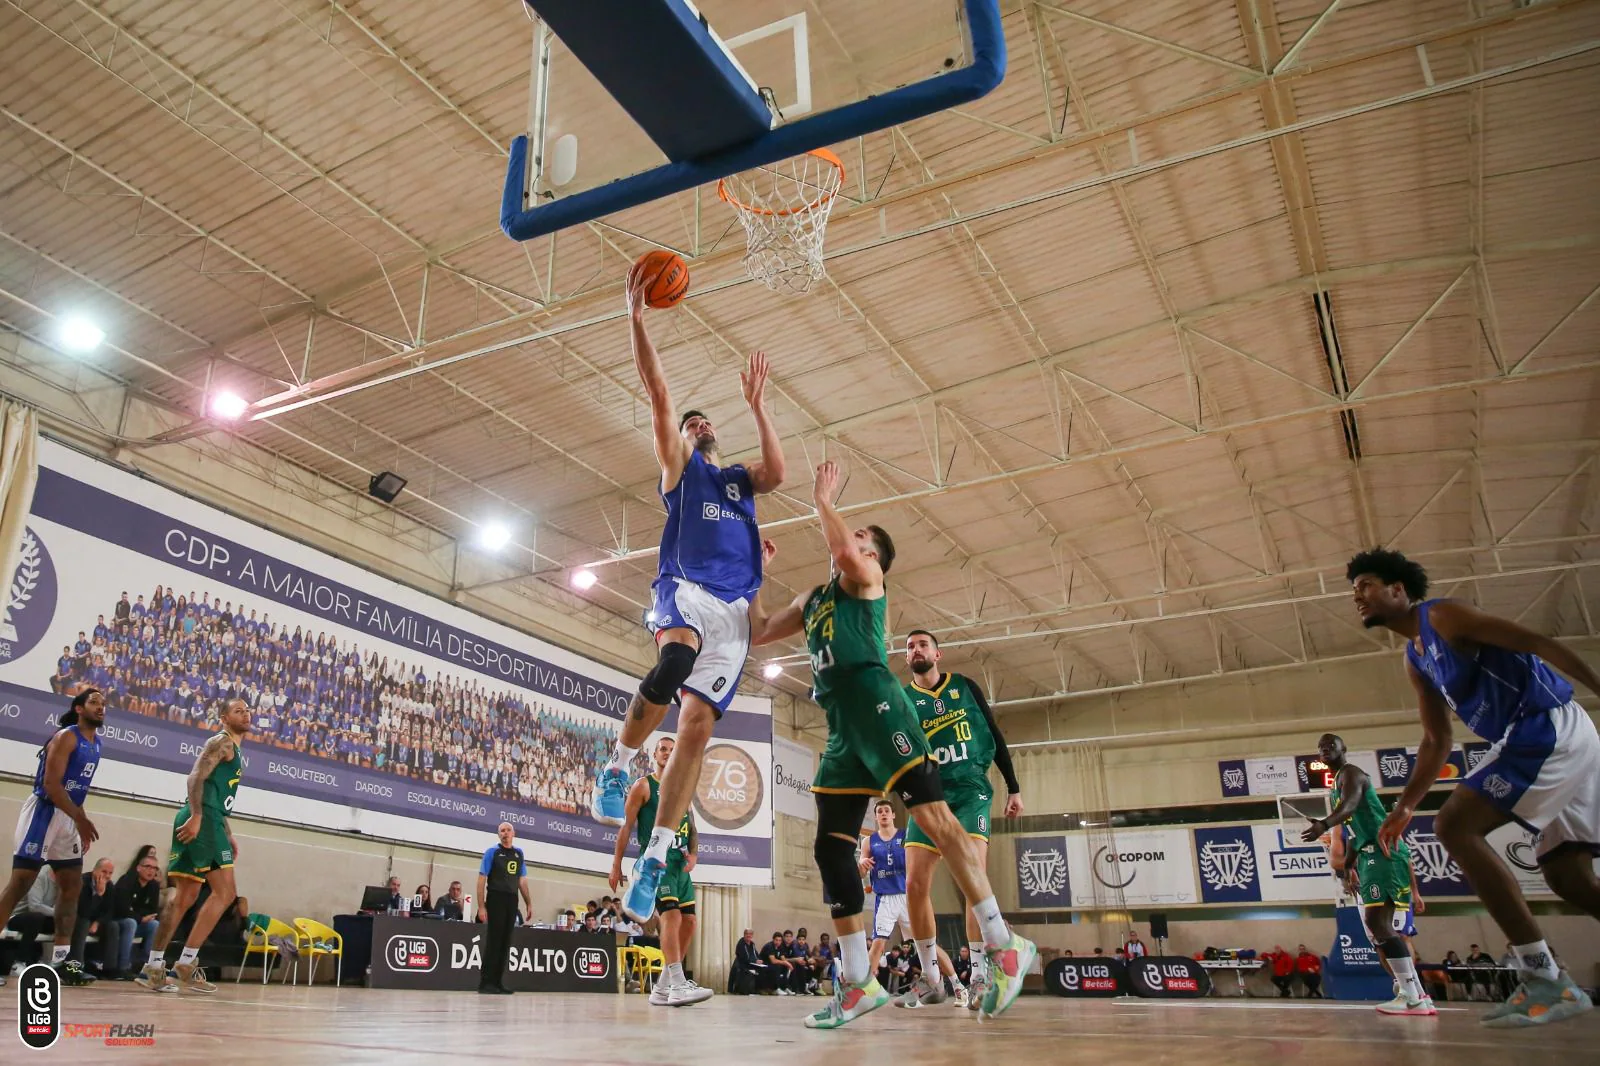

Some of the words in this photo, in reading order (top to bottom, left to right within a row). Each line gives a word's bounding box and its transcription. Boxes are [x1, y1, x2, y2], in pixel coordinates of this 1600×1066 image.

[165, 529, 231, 576] CDP.
[238, 558, 256, 585] A
[263, 565, 350, 619] MAIOR
[356, 599, 442, 652] FAMÍLIA
[447, 633, 559, 693] DESPORTIVA
[562, 676, 583, 701] DA
[586, 684, 628, 716] PÓVO
[822, 617, 835, 641] 4
[953, 720, 972, 742] 10
[933, 742, 969, 765] OLI
[45, 713, 158, 748] AUOBILISMO
[268, 761, 338, 787] BASQUETEBOL
[355, 780, 393, 798] DARDOS
[407, 791, 440, 809] ESCOLA
[441, 799, 451, 809] DE
[453, 801, 487, 817] NATAÇÃO
[573, 826, 592, 837] PATINS
[697, 843, 714, 853] BOL
[716, 844, 741, 854] PRAIA
[705, 758, 747, 788] 76
[1256, 771, 1287, 783] Citymed
[707, 788, 746, 802] ANOS
[887, 853, 894, 866] 5
[1279, 857, 1328, 870] SANIP
[451, 935, 482, 970] DÁ
[508, 947, 567, 974] SALTO
[1085, 979, 1113, 989] Betclic
[1168, 979, 1195, 989] Betclic
